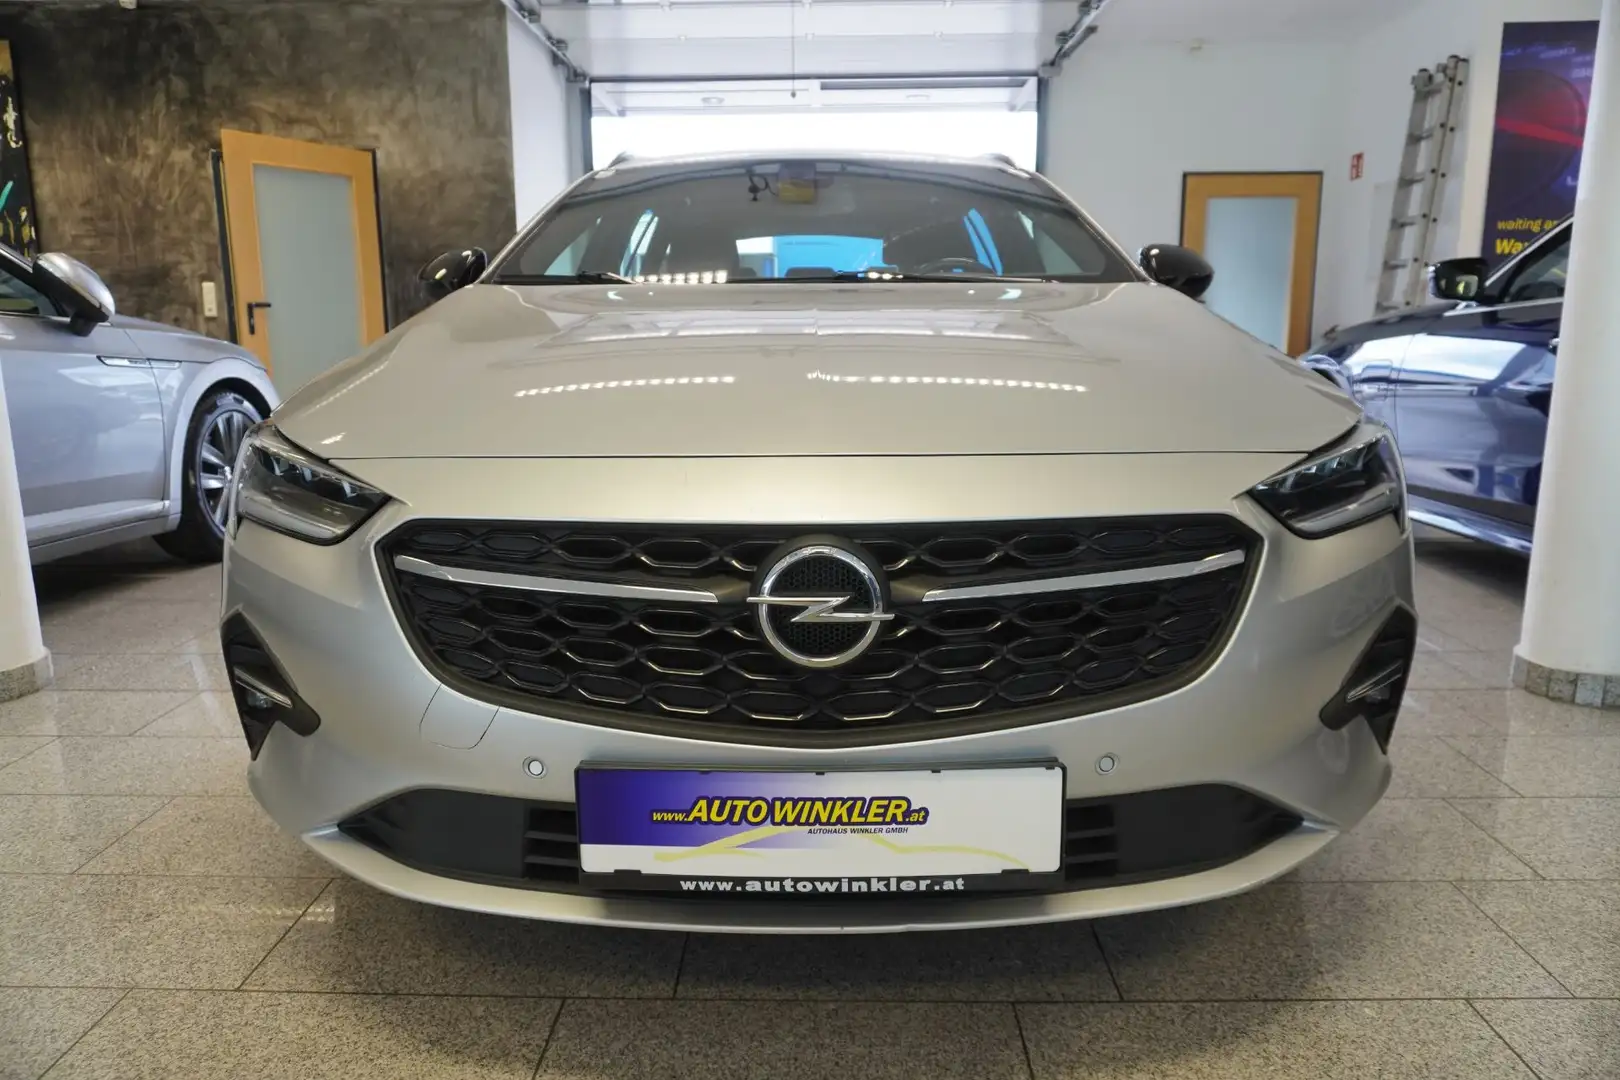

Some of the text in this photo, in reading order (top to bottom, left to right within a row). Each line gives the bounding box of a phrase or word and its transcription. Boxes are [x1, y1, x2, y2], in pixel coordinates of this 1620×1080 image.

[1497, 218, 1542, 233] waiting
[652, 799, 926, 823] www.AUTO WINKLER.at
[807, 827, 848, 835] AUTOHAUS
[679, 878, 965, 893] www.autowinkler.at
